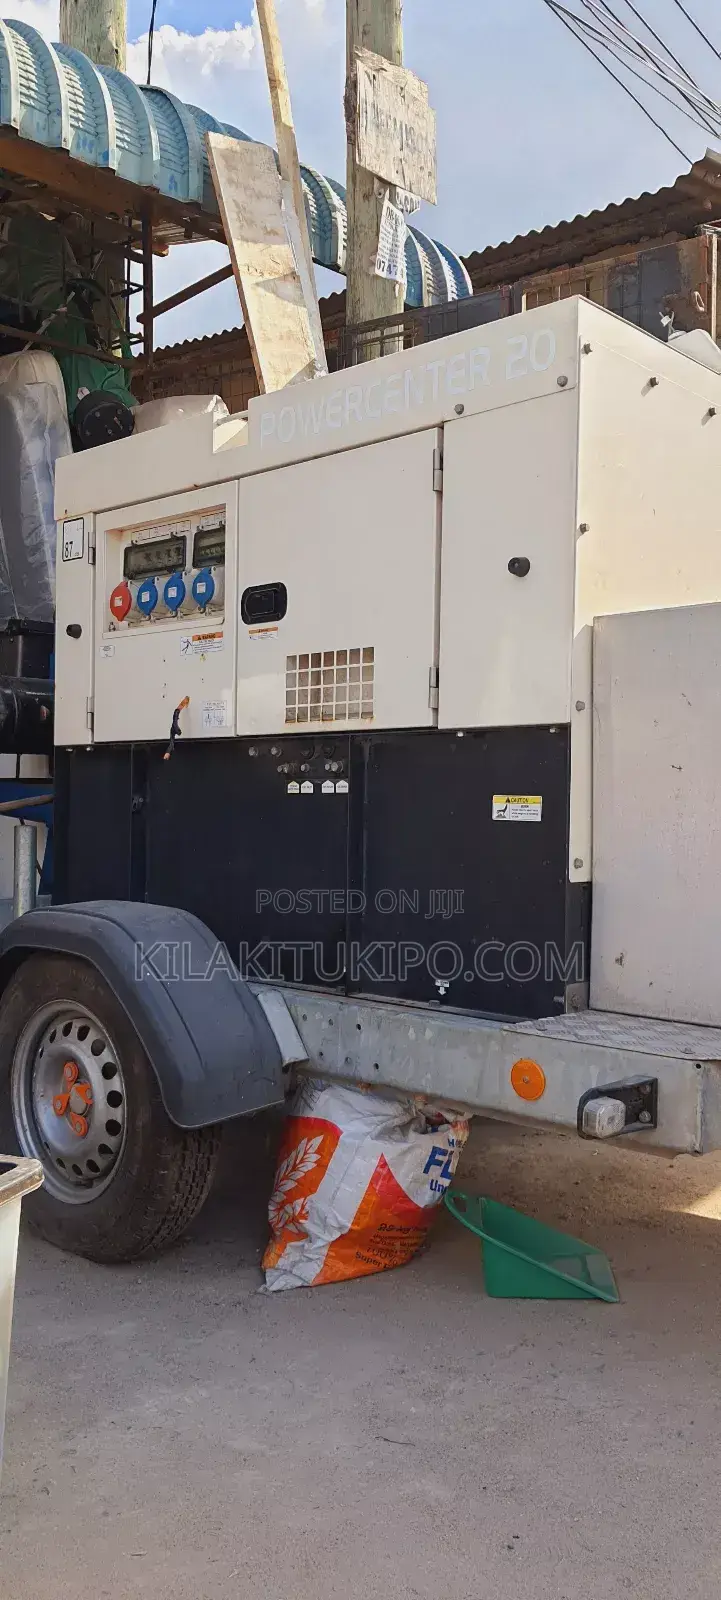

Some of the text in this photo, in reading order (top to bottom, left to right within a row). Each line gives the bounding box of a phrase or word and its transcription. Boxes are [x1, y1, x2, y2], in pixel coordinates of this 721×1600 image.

[258, 328, 556, 448] POWERCENTER 20
[64, 541, 73, 558] 87
[355, 1251, 383, 1268] Super
